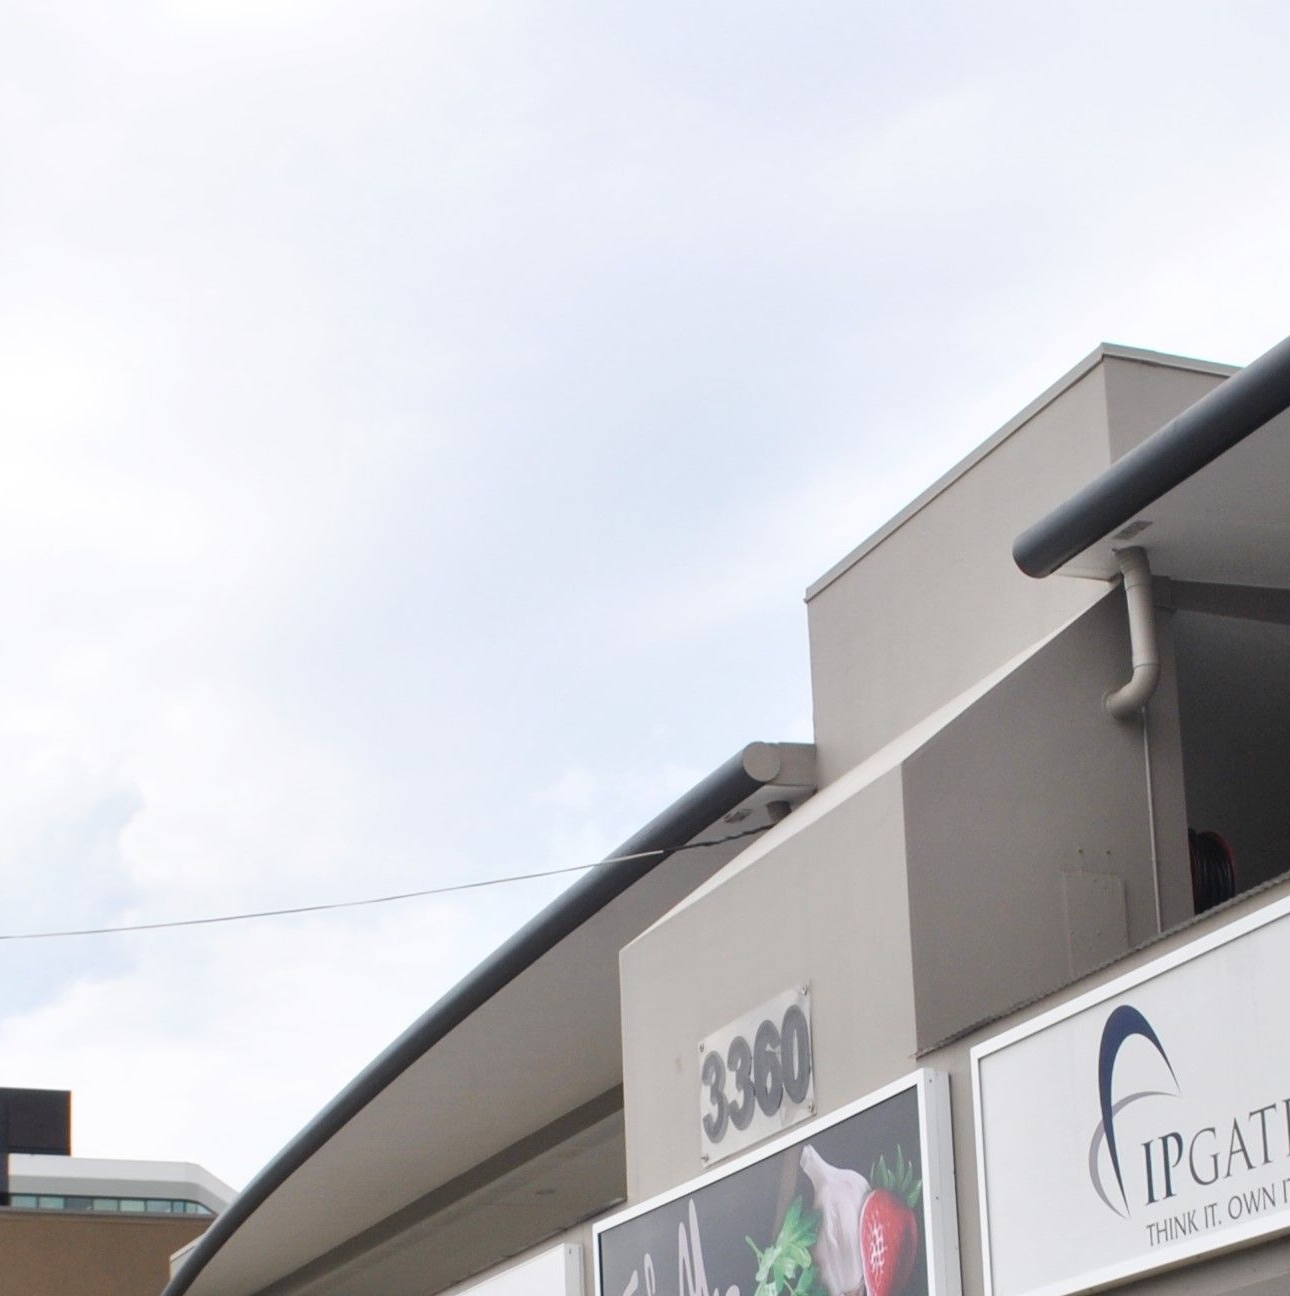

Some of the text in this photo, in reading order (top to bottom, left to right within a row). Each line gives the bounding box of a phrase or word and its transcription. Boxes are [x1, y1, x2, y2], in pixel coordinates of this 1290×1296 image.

[701, 1004, 809, 1143] 3360
[1145, 1209, 1198, 1248] THINK
[1204, 1201, 1223, 1229] IT.
[1228, 1184, 1276, 1222] OWN
